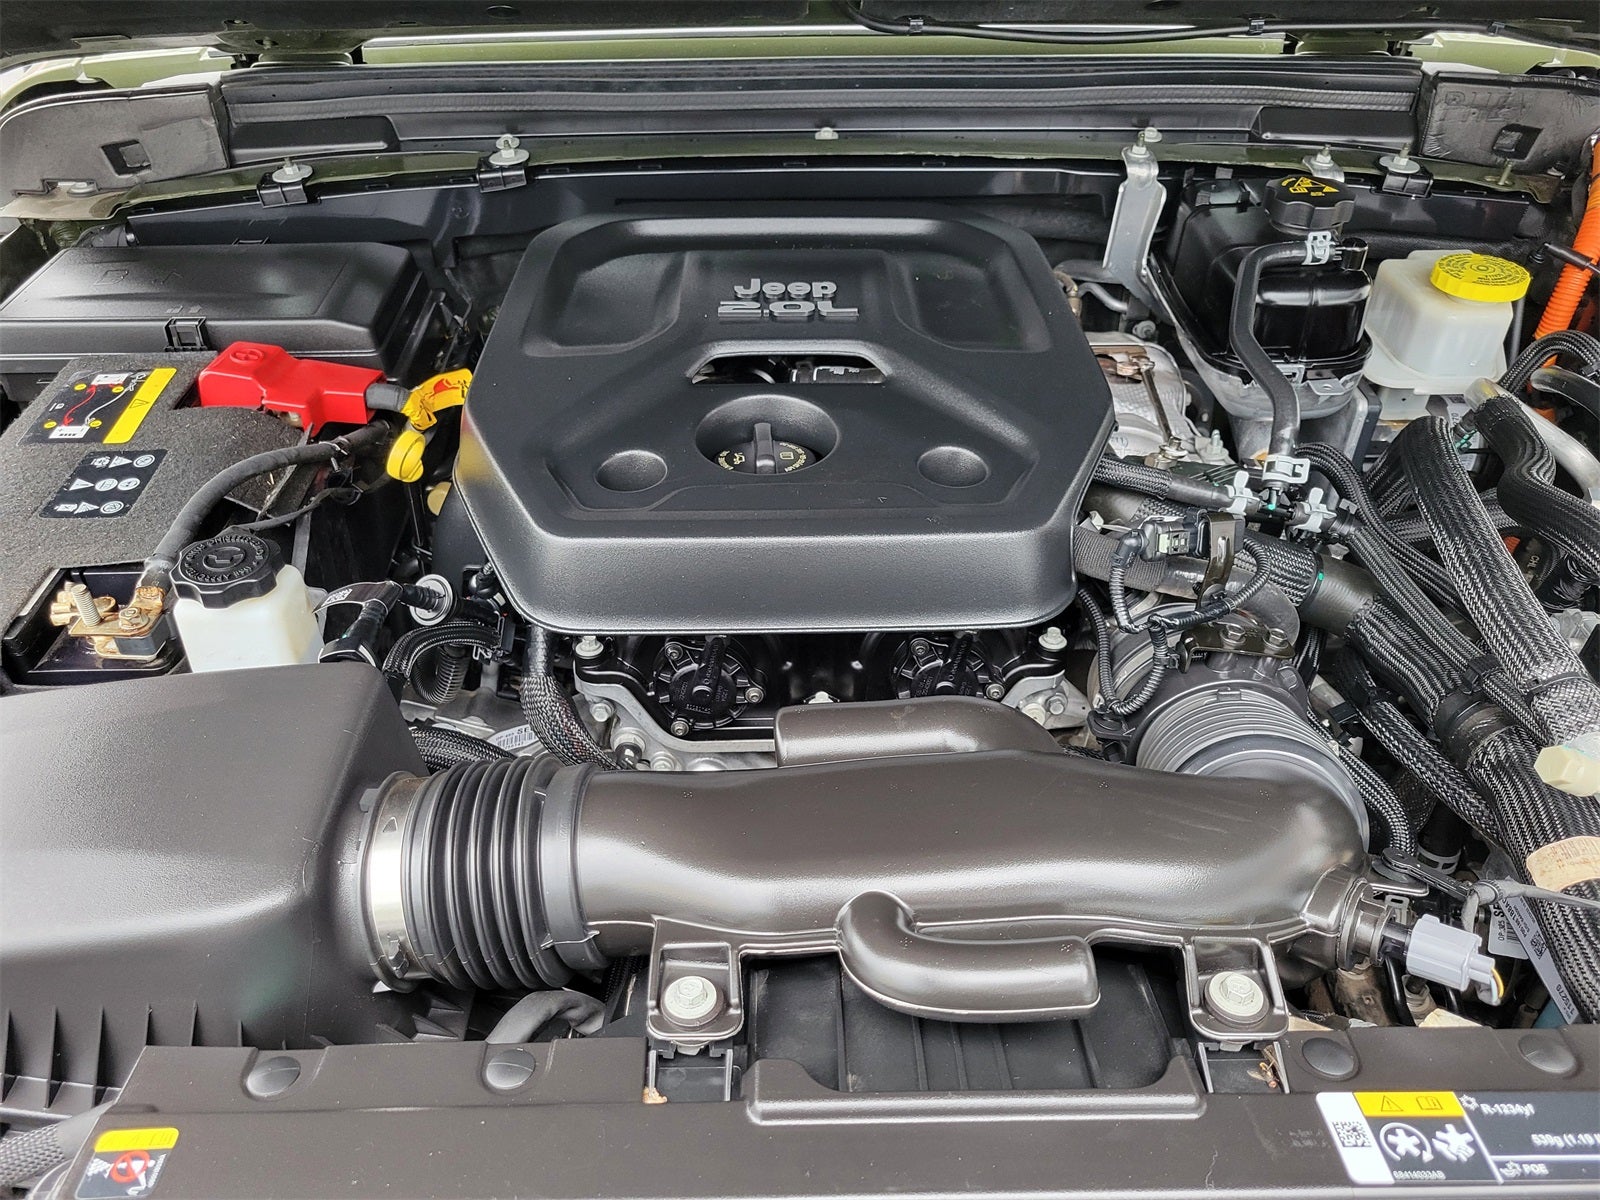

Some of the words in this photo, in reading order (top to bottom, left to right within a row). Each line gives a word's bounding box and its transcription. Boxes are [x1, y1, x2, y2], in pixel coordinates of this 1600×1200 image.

[734, 278, 837, 299] Jeep
[718, 300, 859, 317] 2.0L
[1480, 1103, 1535, 1118] R-1234yf
[1522, 1163, 1549, 1176] POE
